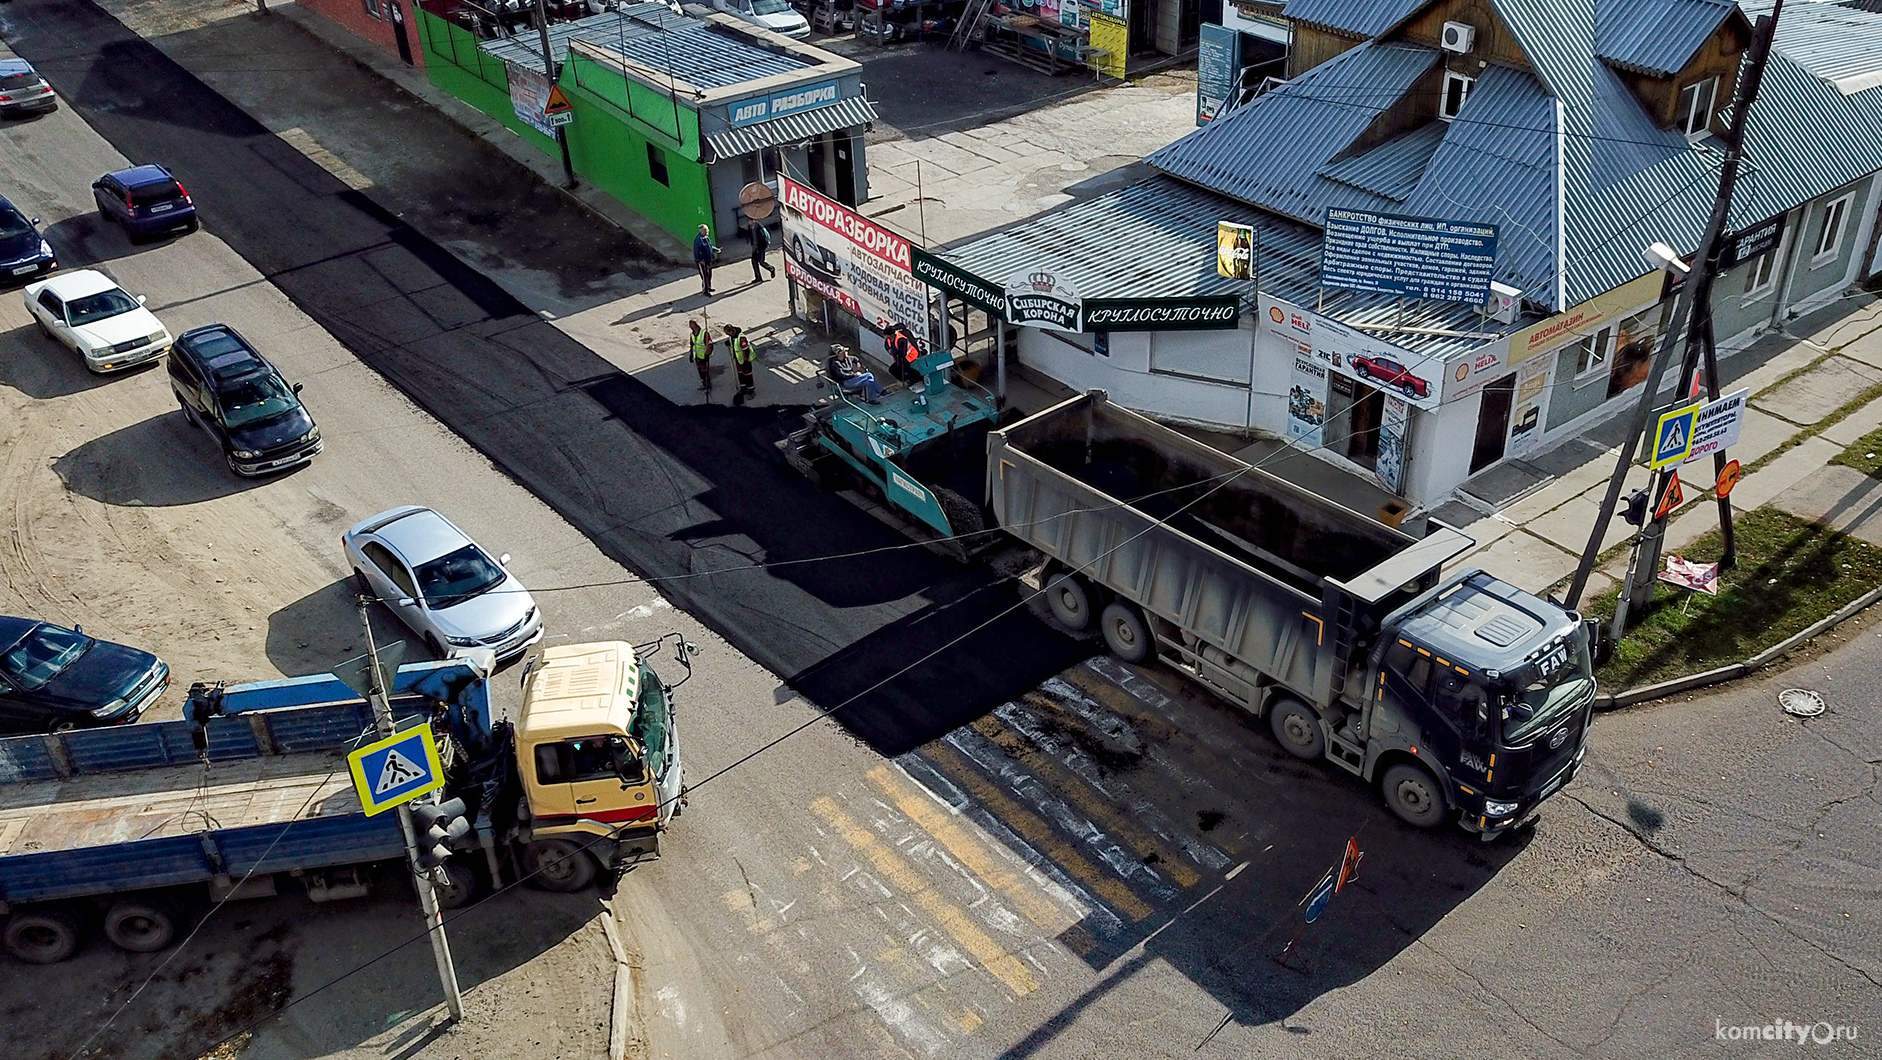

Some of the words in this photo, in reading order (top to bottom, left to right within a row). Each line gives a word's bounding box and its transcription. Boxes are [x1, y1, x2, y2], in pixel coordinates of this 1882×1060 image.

[735, 103, 766, 122] АВТО
[772, 86, 835, 113] РАЗБОРКА
[788, 186, 910, 266] АВТОРАЗБОРКА
[1326, 221, 1359, 232] Взыскание
[1360, 225, 1387, 236] ДОЛГОВ.
[1388, 229, 1439, 242] Исполнительное
[1329, 209, 1377, 223] БАНКРОТСТВО
[1377, 216, 1419, 229] физических
[852, 246, 923, 292] АВТОЗАПЧАСТИ
[1395, 267, 1460, 282] Представительство
[790, 265, 844, 305] ОРЛОВСКАЯ,
[844, 298, 856, 310] 41
[847, 274, 890, 305] КУЗОВНАЯ
[893, 301, 925, 324] ЧАСТЬ
[851, 262, 890, 295] ХОДОВАЯ
[893, 285, 925, 311] ЧАСТЬ
[917, 259, 1005, 311] КРУГЛОСУТОЧНО
[887, 309, 925, 337] ОПТИКА
[1023, 308, 1066, 325] КОРОНА
[1087, 306, 1235, 324] КРУГЛОСУТОЧНО
[1528, 313, 1584, 345] АВТОМАГАЗИН
[1318, 350, 1331, 361] ZIC
[1474, 352, 1497, 371] HELIX
[1295, 362, 1325, 380] ГАРАНТИЯ
[1541, 648, 1569, 677] FAW
